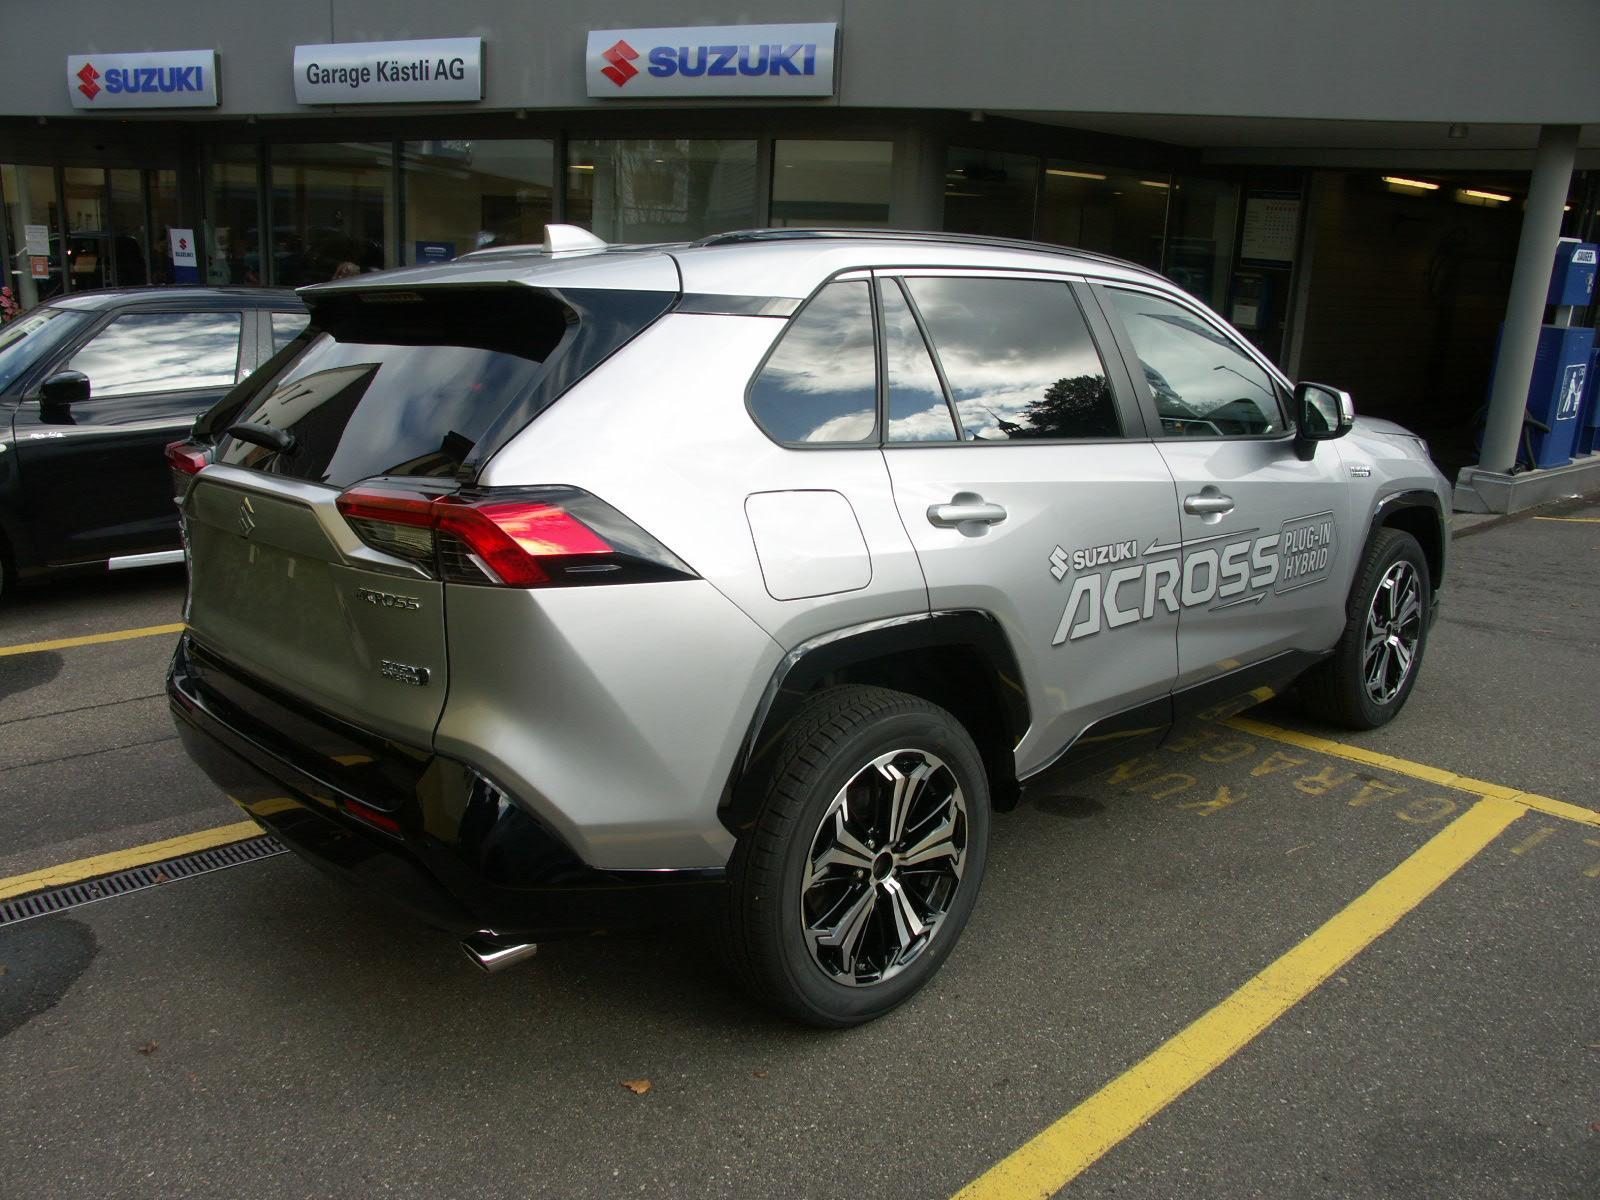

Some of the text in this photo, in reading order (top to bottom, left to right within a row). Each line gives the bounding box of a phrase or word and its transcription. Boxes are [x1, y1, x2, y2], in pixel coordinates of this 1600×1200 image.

[307, 58, 465, 88] Garage Kästli AG
[648, 44, 815, 77] SUZUKI
[105, 66, 203, 93] SUZUKI
[1284, 520, 1332, 555] PLUG-IN
[1072, 540, 1137, 571] SUZUKI
[1284, 548, 1329, 580] HYBRID
[1051, 533, 1282, 646] ACROSS
